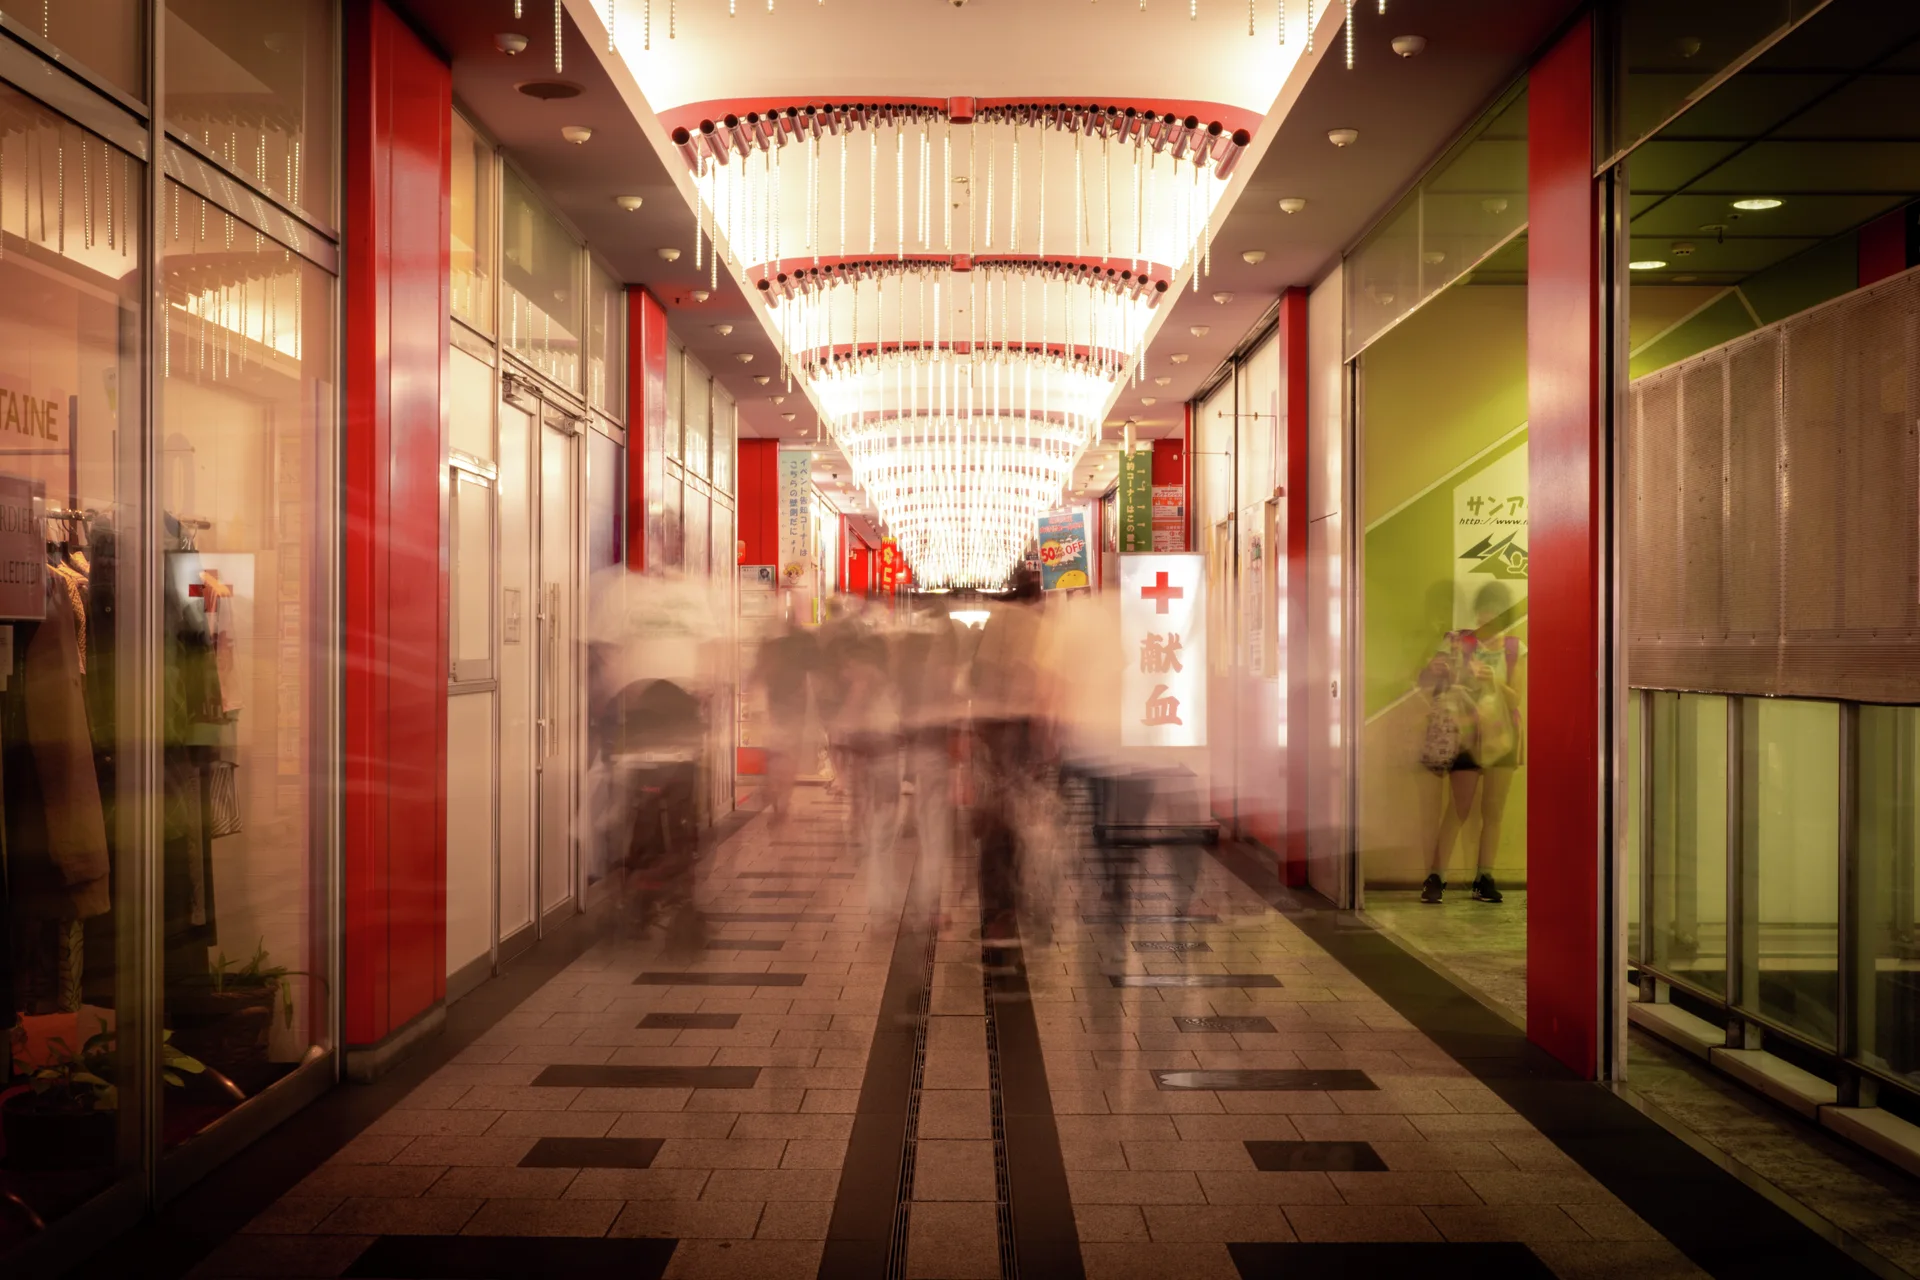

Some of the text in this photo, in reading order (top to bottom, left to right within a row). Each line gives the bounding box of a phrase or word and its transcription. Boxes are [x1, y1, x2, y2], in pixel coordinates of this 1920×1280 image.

[1466, 496, 1528, 516] サンア
[1065, 540, 1085, 555] OFF
[1140, 631, 1183, 727] 献血
